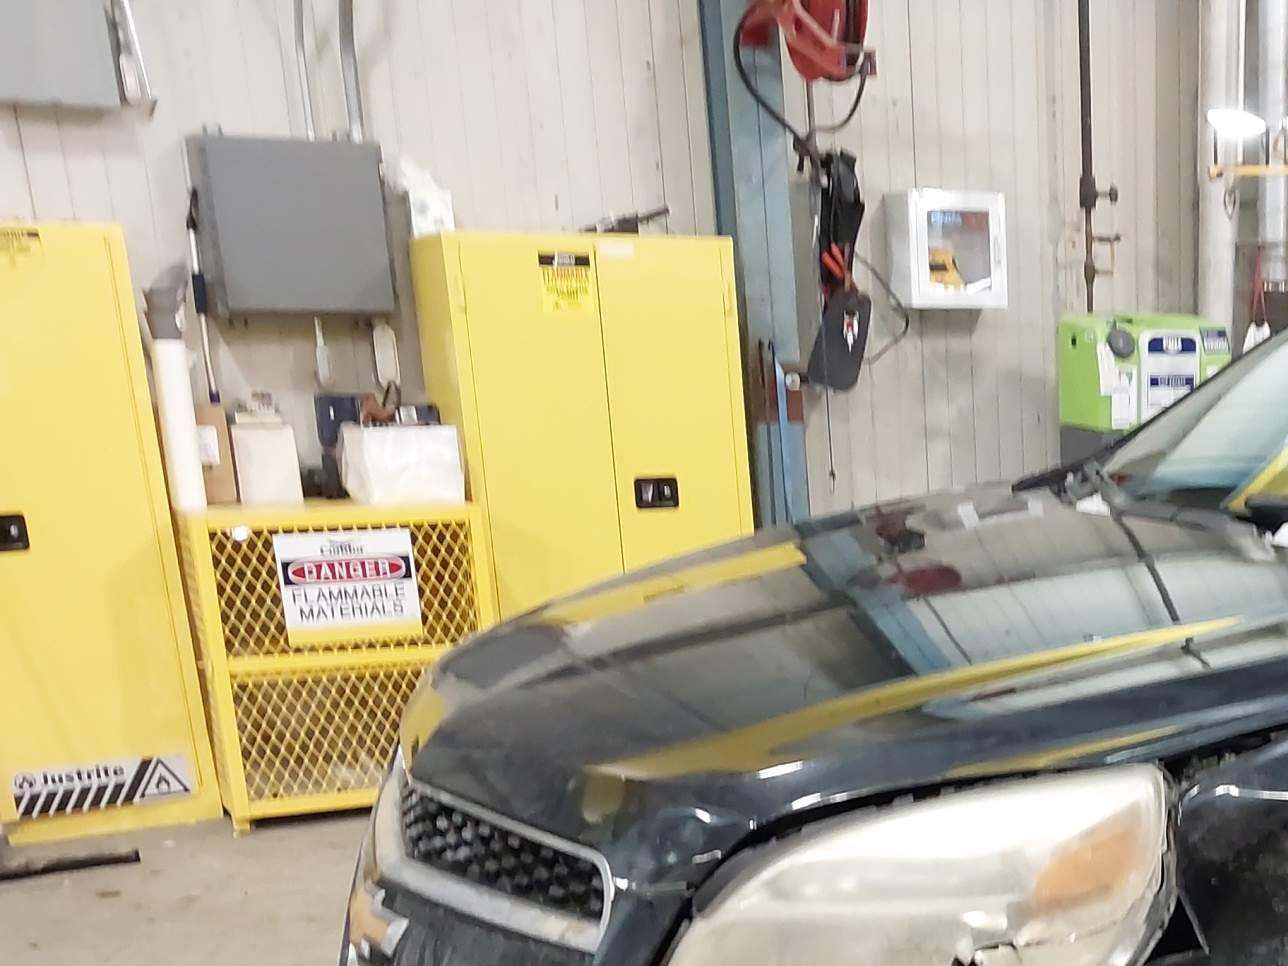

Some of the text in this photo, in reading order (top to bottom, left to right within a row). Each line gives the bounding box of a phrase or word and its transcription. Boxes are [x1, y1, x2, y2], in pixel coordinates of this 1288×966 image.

[304, 559, 390, 582] DANGER
[292, 582, 405, 605] FLAMMABLE
[300, 600, 404, 623] MATERIALS
